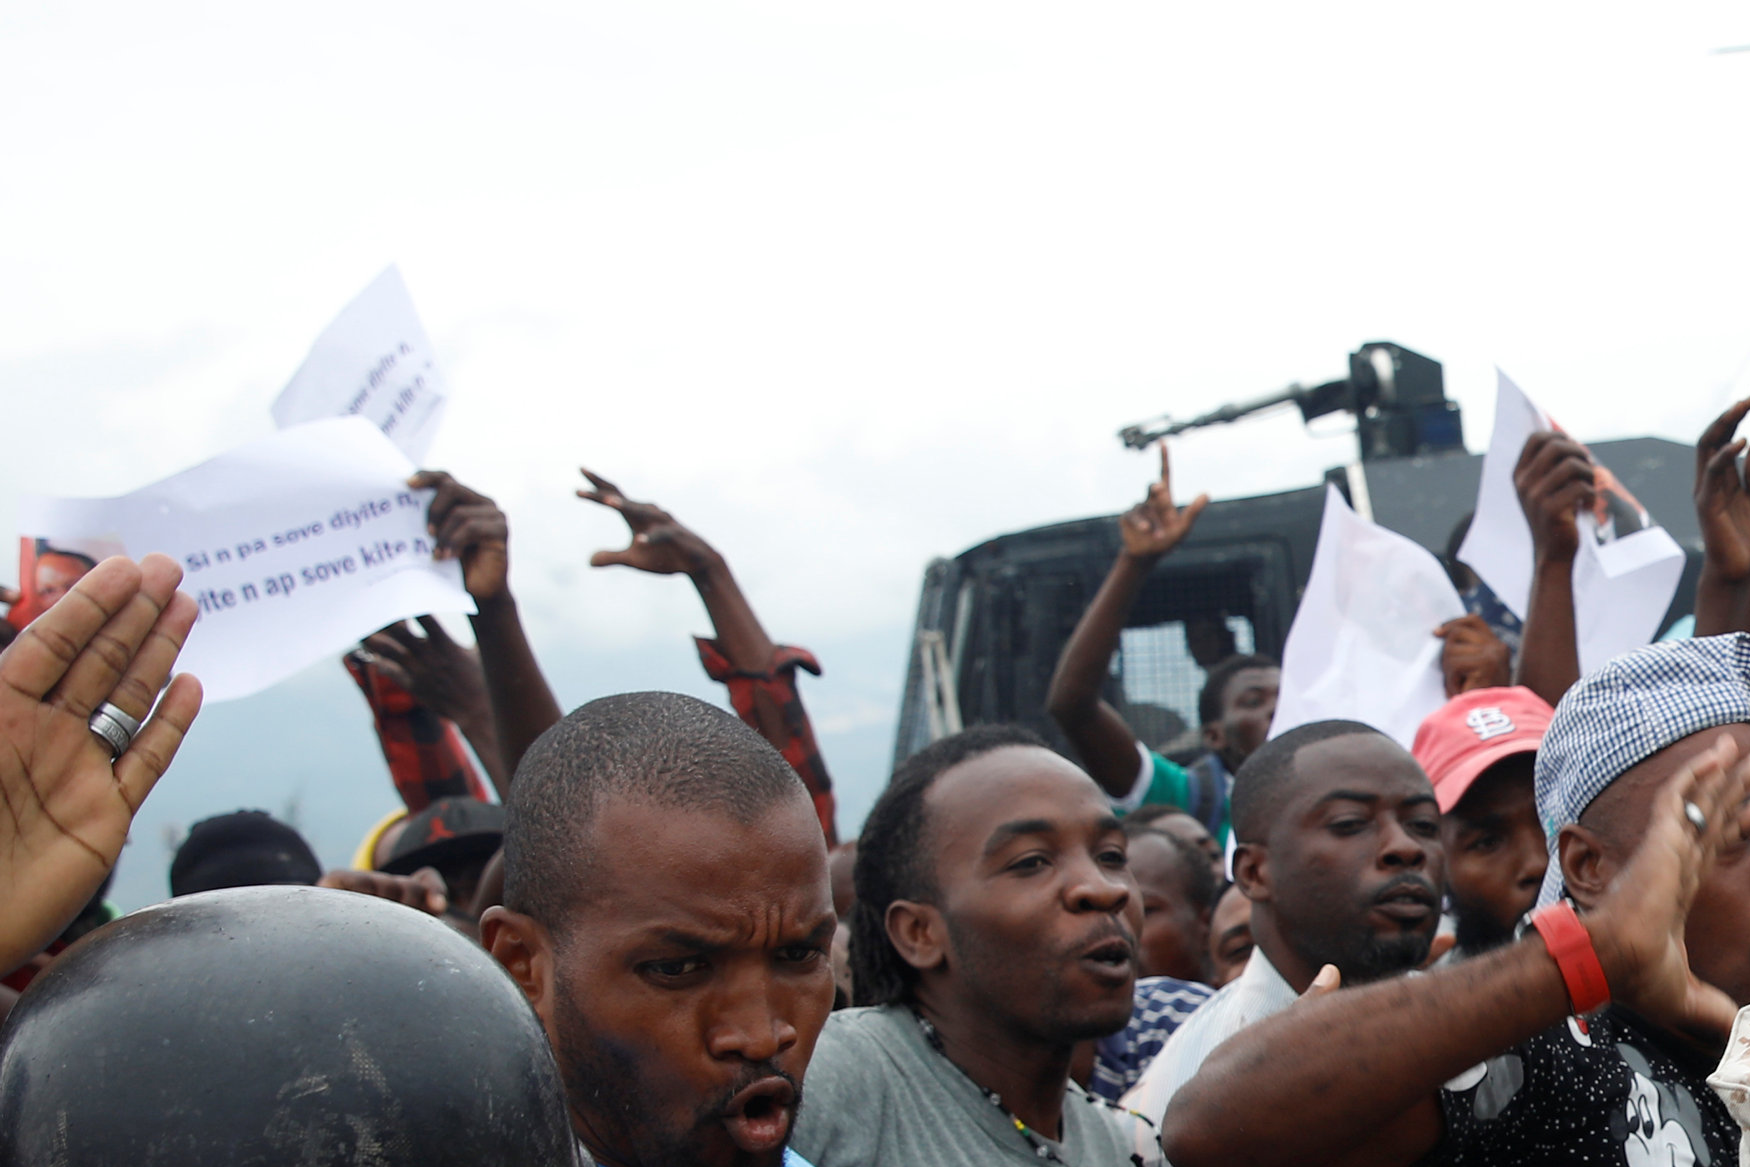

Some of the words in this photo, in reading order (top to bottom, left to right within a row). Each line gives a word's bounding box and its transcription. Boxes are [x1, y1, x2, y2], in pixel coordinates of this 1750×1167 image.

[186, 551, 210, 572] Si
[216, 546, 232, 563] n
[237, 538, 266, 560] pa
[273, 521, 324, 547] sove
[330, 497, 392, 529] diyite
[241, 582, 259, 602] n
[265, 570, 297, 597] ap
[301, 556, 356, 586] sove
[359, 537, 408, 567] kite
